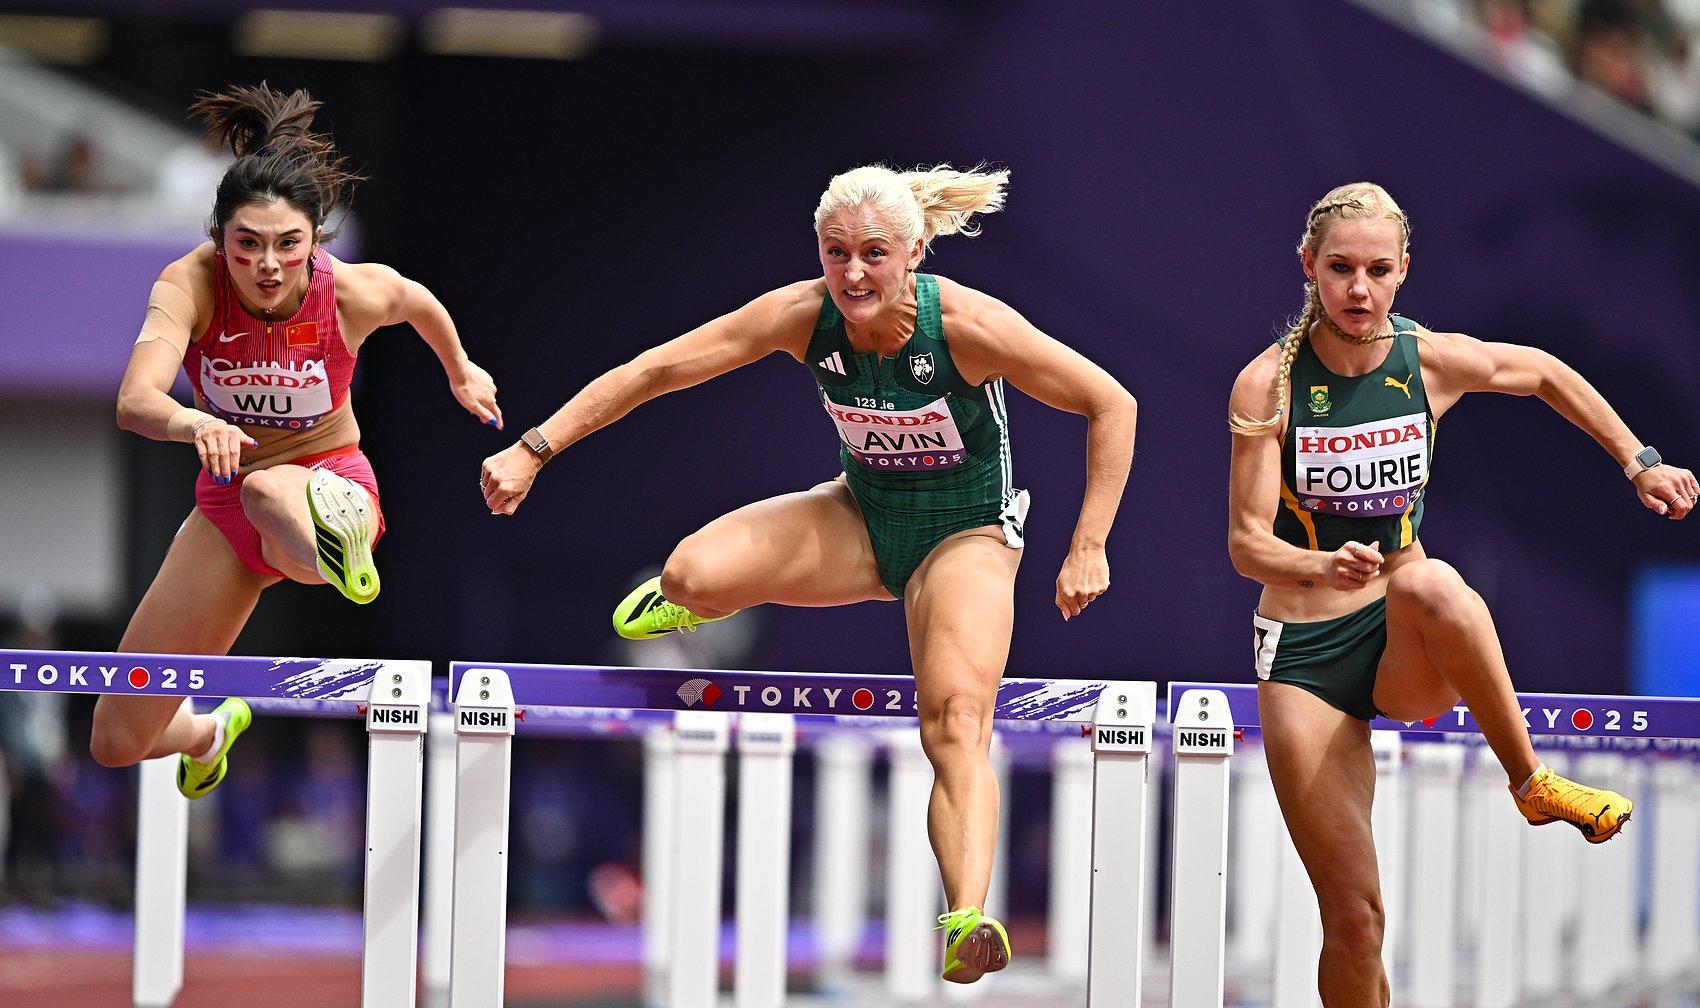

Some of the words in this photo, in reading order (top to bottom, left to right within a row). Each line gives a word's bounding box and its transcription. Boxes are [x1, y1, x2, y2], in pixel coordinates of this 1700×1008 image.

[202, 366, 325, 389] HONDA
[232, 394, 293, 415] WU
[823, 400, 949, 427] HONDA
[841, 427, 947, 452] LAVIN
[1298, 423, 1424, 454] HONDA
[1305, 453, 1422, 493] FOURIE
[885, 690, 918, 711] 2
[372, 708, 419, 725] NISHI
[460, 711, 507, 727] NISHI
[1098, 729, 1144, 746] NISHI
[1179, 732, 1226, 748] NISHI
